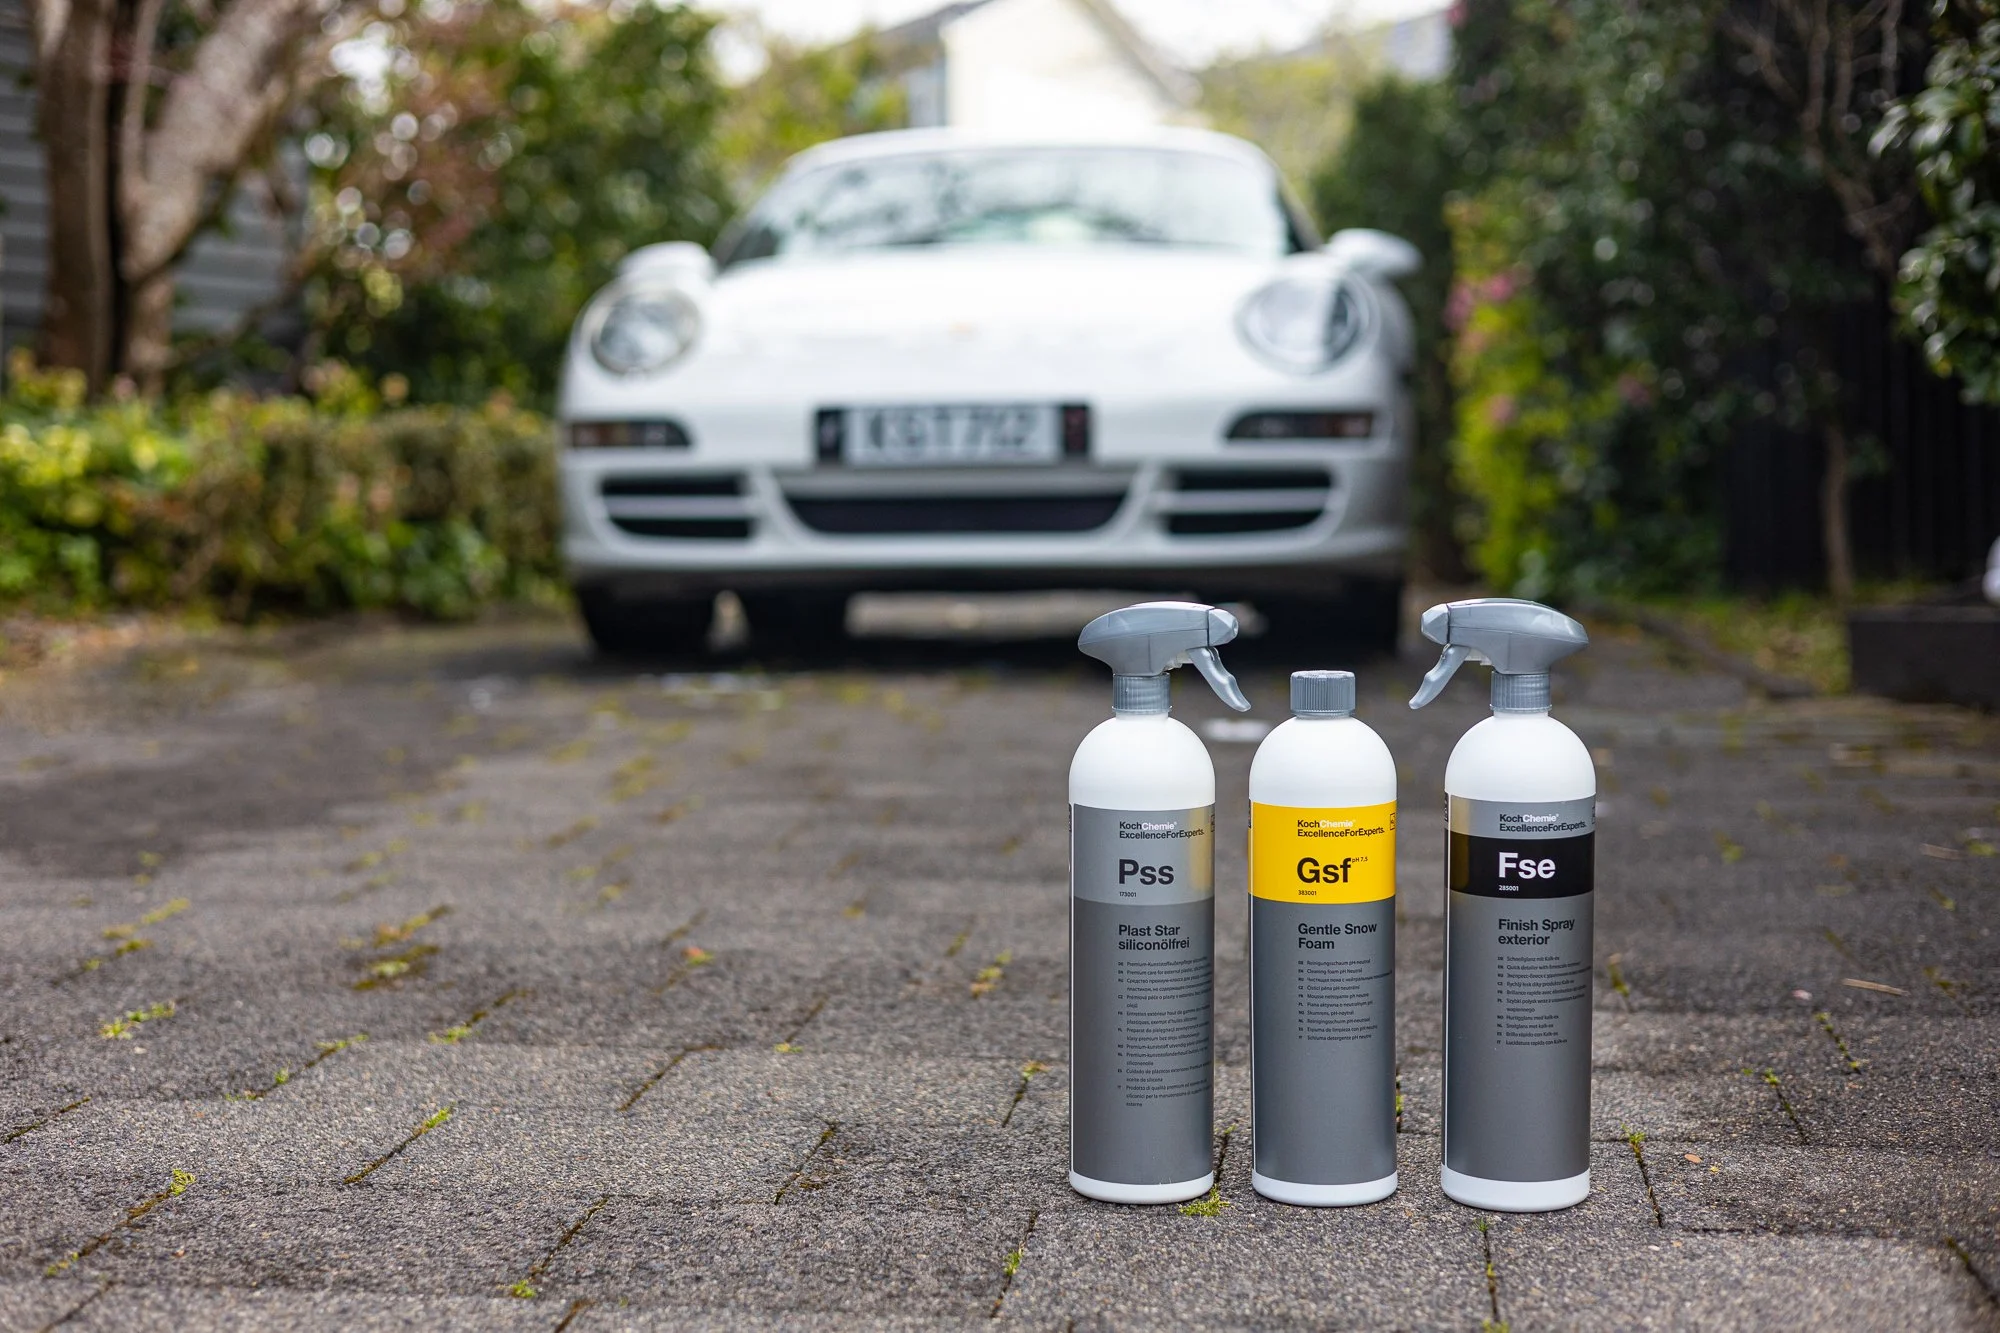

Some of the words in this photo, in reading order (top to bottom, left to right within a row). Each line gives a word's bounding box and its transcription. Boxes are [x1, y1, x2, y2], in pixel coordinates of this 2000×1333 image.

[1119, 858, 1174, 885] Pss
[1297, 857, 1351, 884] Gsf
[1499, 852, 1556, 879] Fse
[1119, 925, 1151, 936] Plast
[1154, 924, 1180, 936] Star
[1298, 924, 1341, 935] Gentle
[1345, 923, 1377, 934] Snow
[1499, 919, 1538, 930] Finish
[1542, 918, 1575, 932] Spray
[1118, 937, 1190, 950] siliconölfrei
[1299, 938, 1334, 949] Foam
[1498, 934, 1550, 945] exterior
